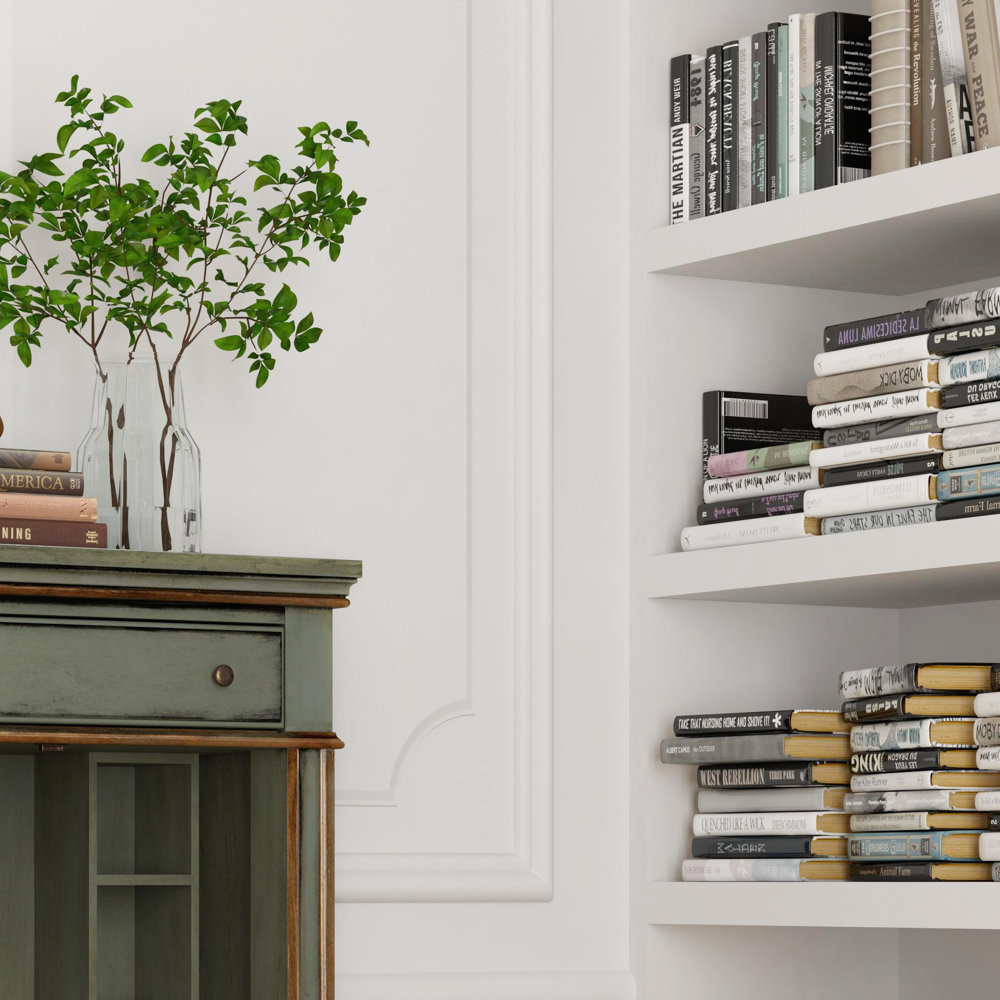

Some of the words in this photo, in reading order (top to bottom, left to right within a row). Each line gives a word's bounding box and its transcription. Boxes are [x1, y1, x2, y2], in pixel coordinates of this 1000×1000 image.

[913, 54, 921, 106] Revolution
[964, 12, 979, 60] WAR
[972, 74, 989, 139] PEACE
[672, 127, 684, 195] MARTIAN
[678, 718, 690, 730] TAKE
[690, 717, 701, 729] THAT
[701, 717, 723, 729] NURSING
[722, 716, 737, 728] HOME
[736, 716, 747, 728] AND
[747, 715, 763, 727] SHOVE
[851, 751, 881, 773] KING
[700, 769, 721, 786] WEST
[722, 768, 765, 786] REBELLION
[701, 817, 731, 835] QUENCHED
[731, 817, 744, 831] LIKE
[744, 817, 750, 830] A
[750, 816, 765, 830] WICK
